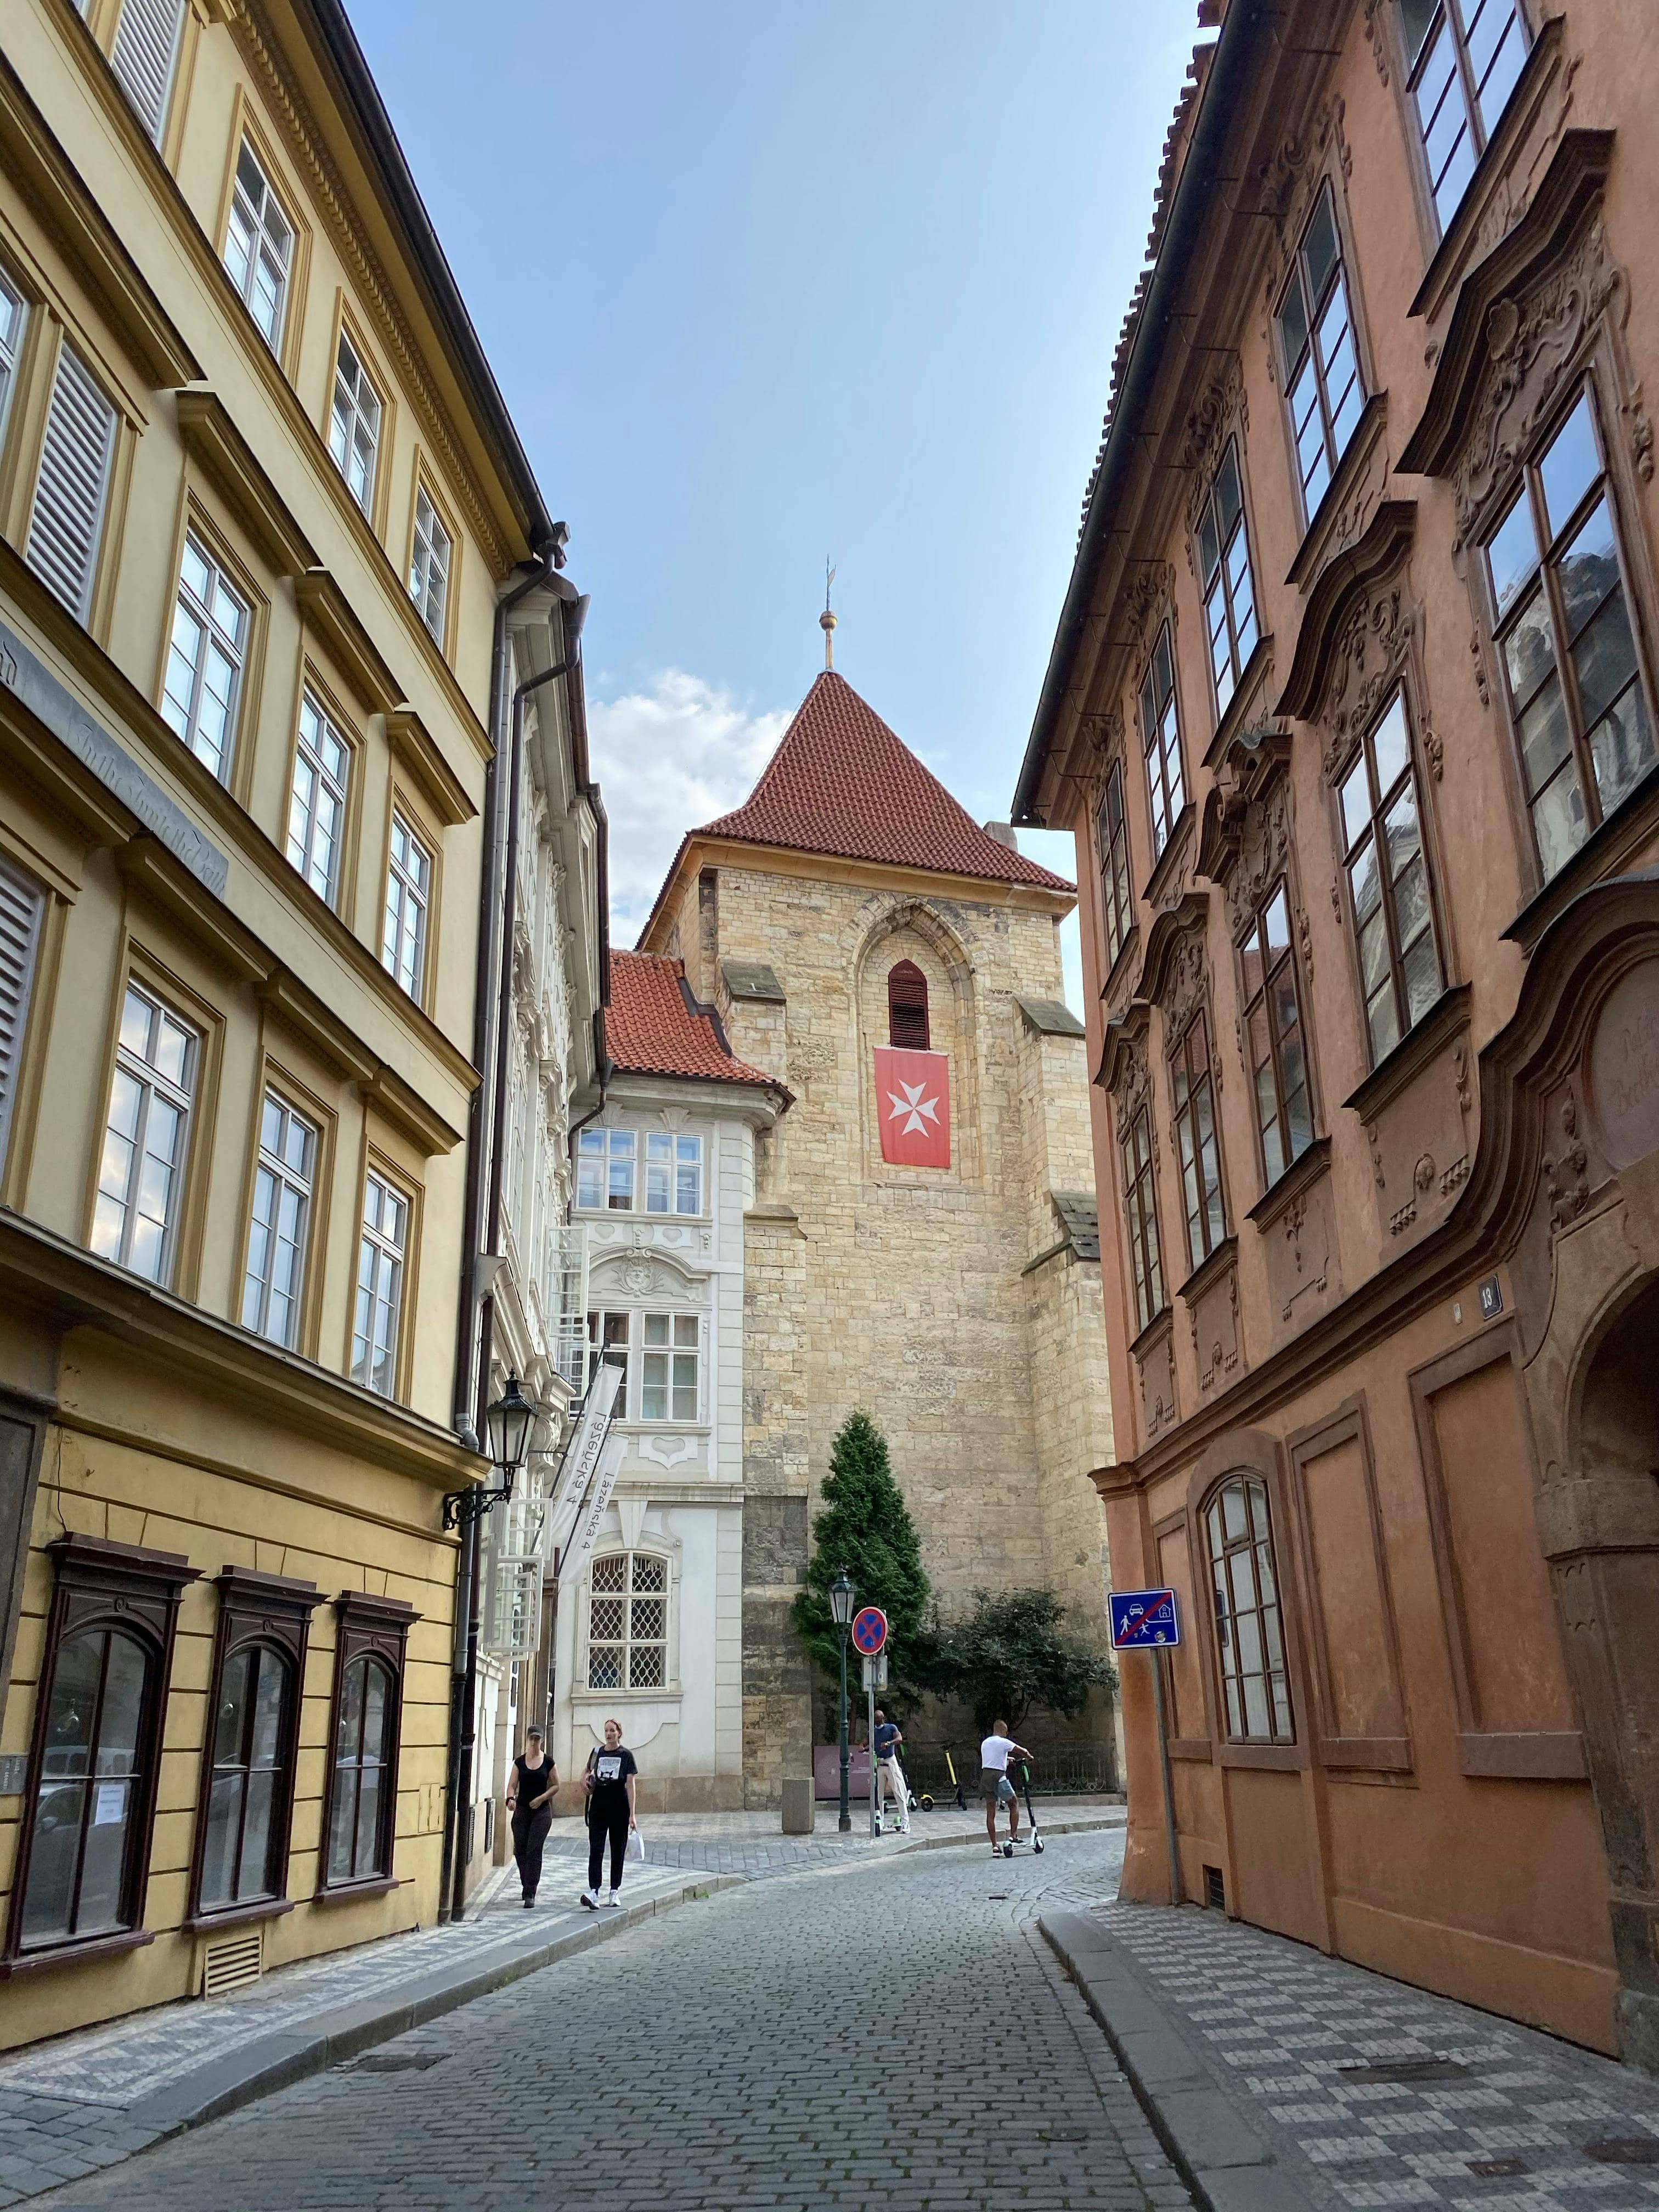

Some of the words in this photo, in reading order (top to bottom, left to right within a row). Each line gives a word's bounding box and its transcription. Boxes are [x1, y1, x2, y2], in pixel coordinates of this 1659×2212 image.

[1482, 1287, 1493, 1309] 13
[586, 1472, 615, 1537] Lázeňská
[581, 1541, 590, 1550] 4
